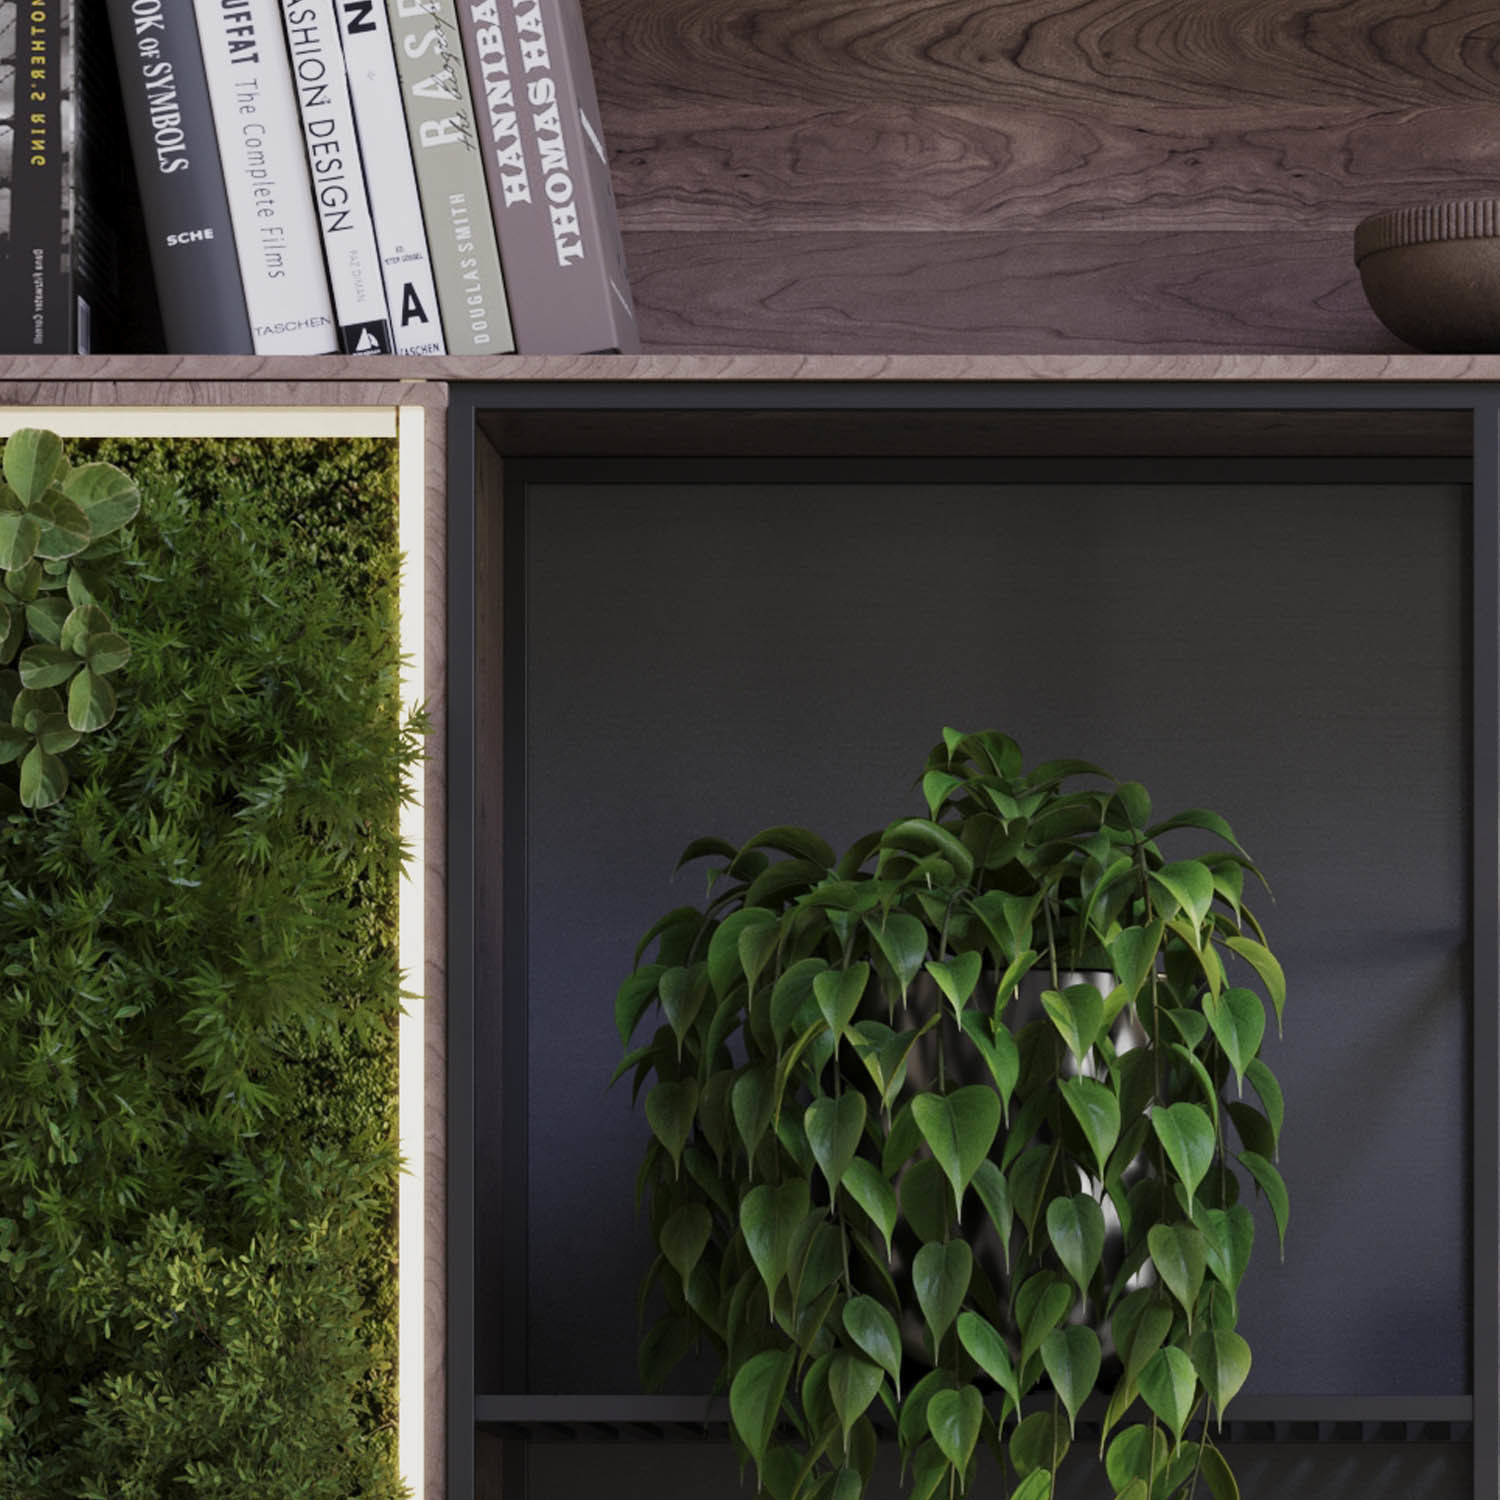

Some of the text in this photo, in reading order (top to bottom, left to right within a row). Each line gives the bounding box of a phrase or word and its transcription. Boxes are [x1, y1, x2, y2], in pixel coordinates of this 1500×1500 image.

[137, 37, 160, 59] OF
[142, 61, 190, 174] SYMBOLS
[234, 78, 261, 114] The
[242, 122, 276, 218] Complete
[307, 119, 354, 233] DESIGN
[526, 78, 585, 267] THOMAS
[166, 228, 215, 247] SCHE
[259, 226, 287, 279] Films
[448, 193, 490, 345] DOUGLAS SMITH
[253, 316, 332, 337] TASCHEN
[400, 282, 429, 327] A
